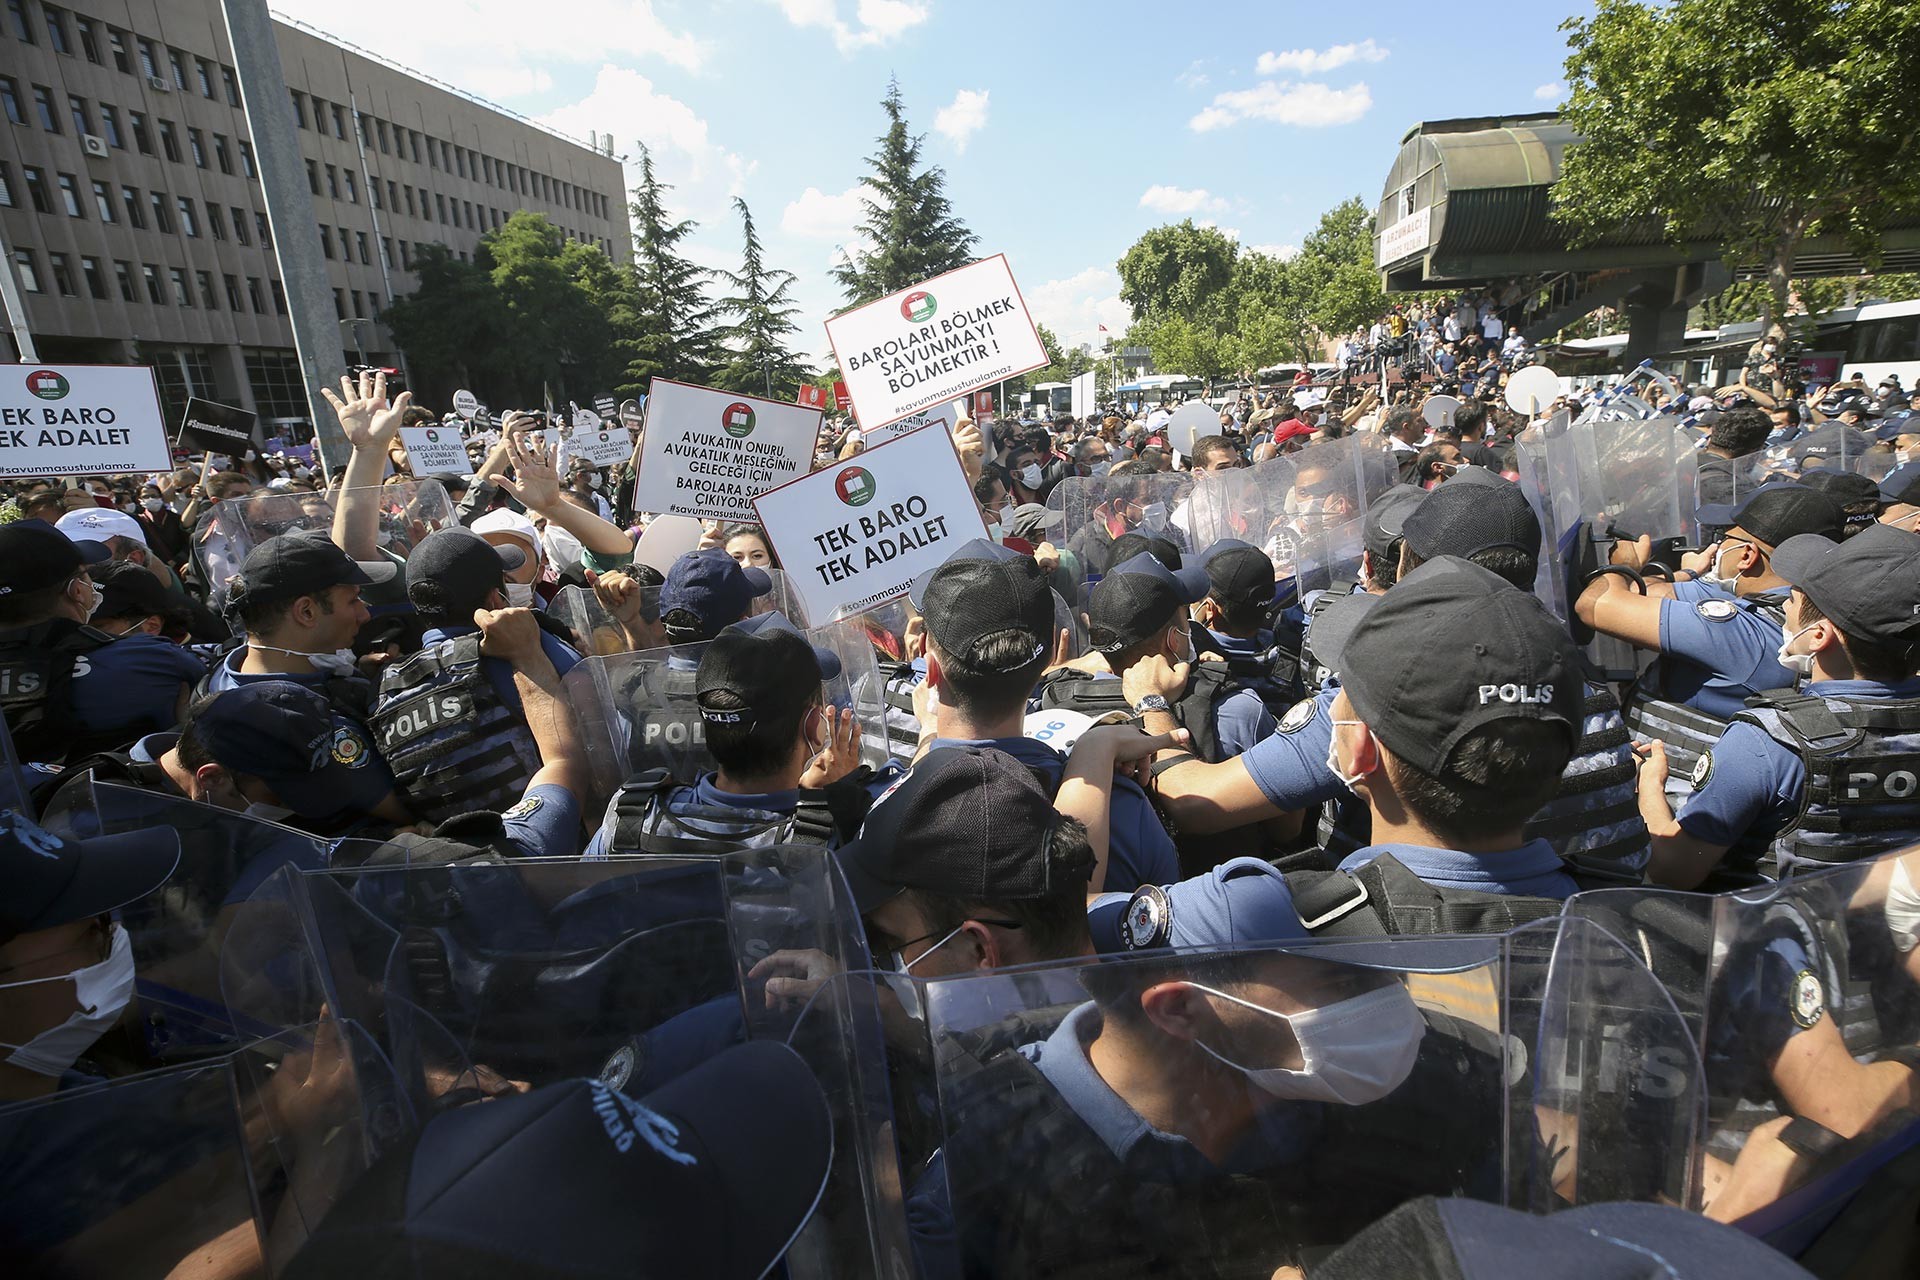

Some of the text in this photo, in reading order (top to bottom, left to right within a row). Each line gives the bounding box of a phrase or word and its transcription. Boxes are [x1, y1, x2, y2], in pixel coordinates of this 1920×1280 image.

[848, 296, 1015, 371] BAROLARI BÖLMEK
[880, 322, 994, 377] SAVUNMAYI
[888, 344, 989, 394] BÖLMEKTİR
[895, 365, 1013, 414] #savunmasusturulamaz
[1, 407, 116, 426] EK BARO
[0, 428, 130, 448] EK ADALET
[681, 431, 786, 458] AVUKATIN ONURU,
[0, 463, 136, 474] #savunmasusturulamaz
[663, 443, 797, 472] AVUKATLIK MESLEĞİNİN
[688, 461, 773, 483] GELECEĞİ İÇİN
[676, 476, 742, 496] BAROLARA
[694, 492, 754, 511] ÇIKIYORU
[813, 495, 927, 556] TEK BARO
[815, 515, 948, 586] TEK ADALET
[645, 721, 707, 745] POL
